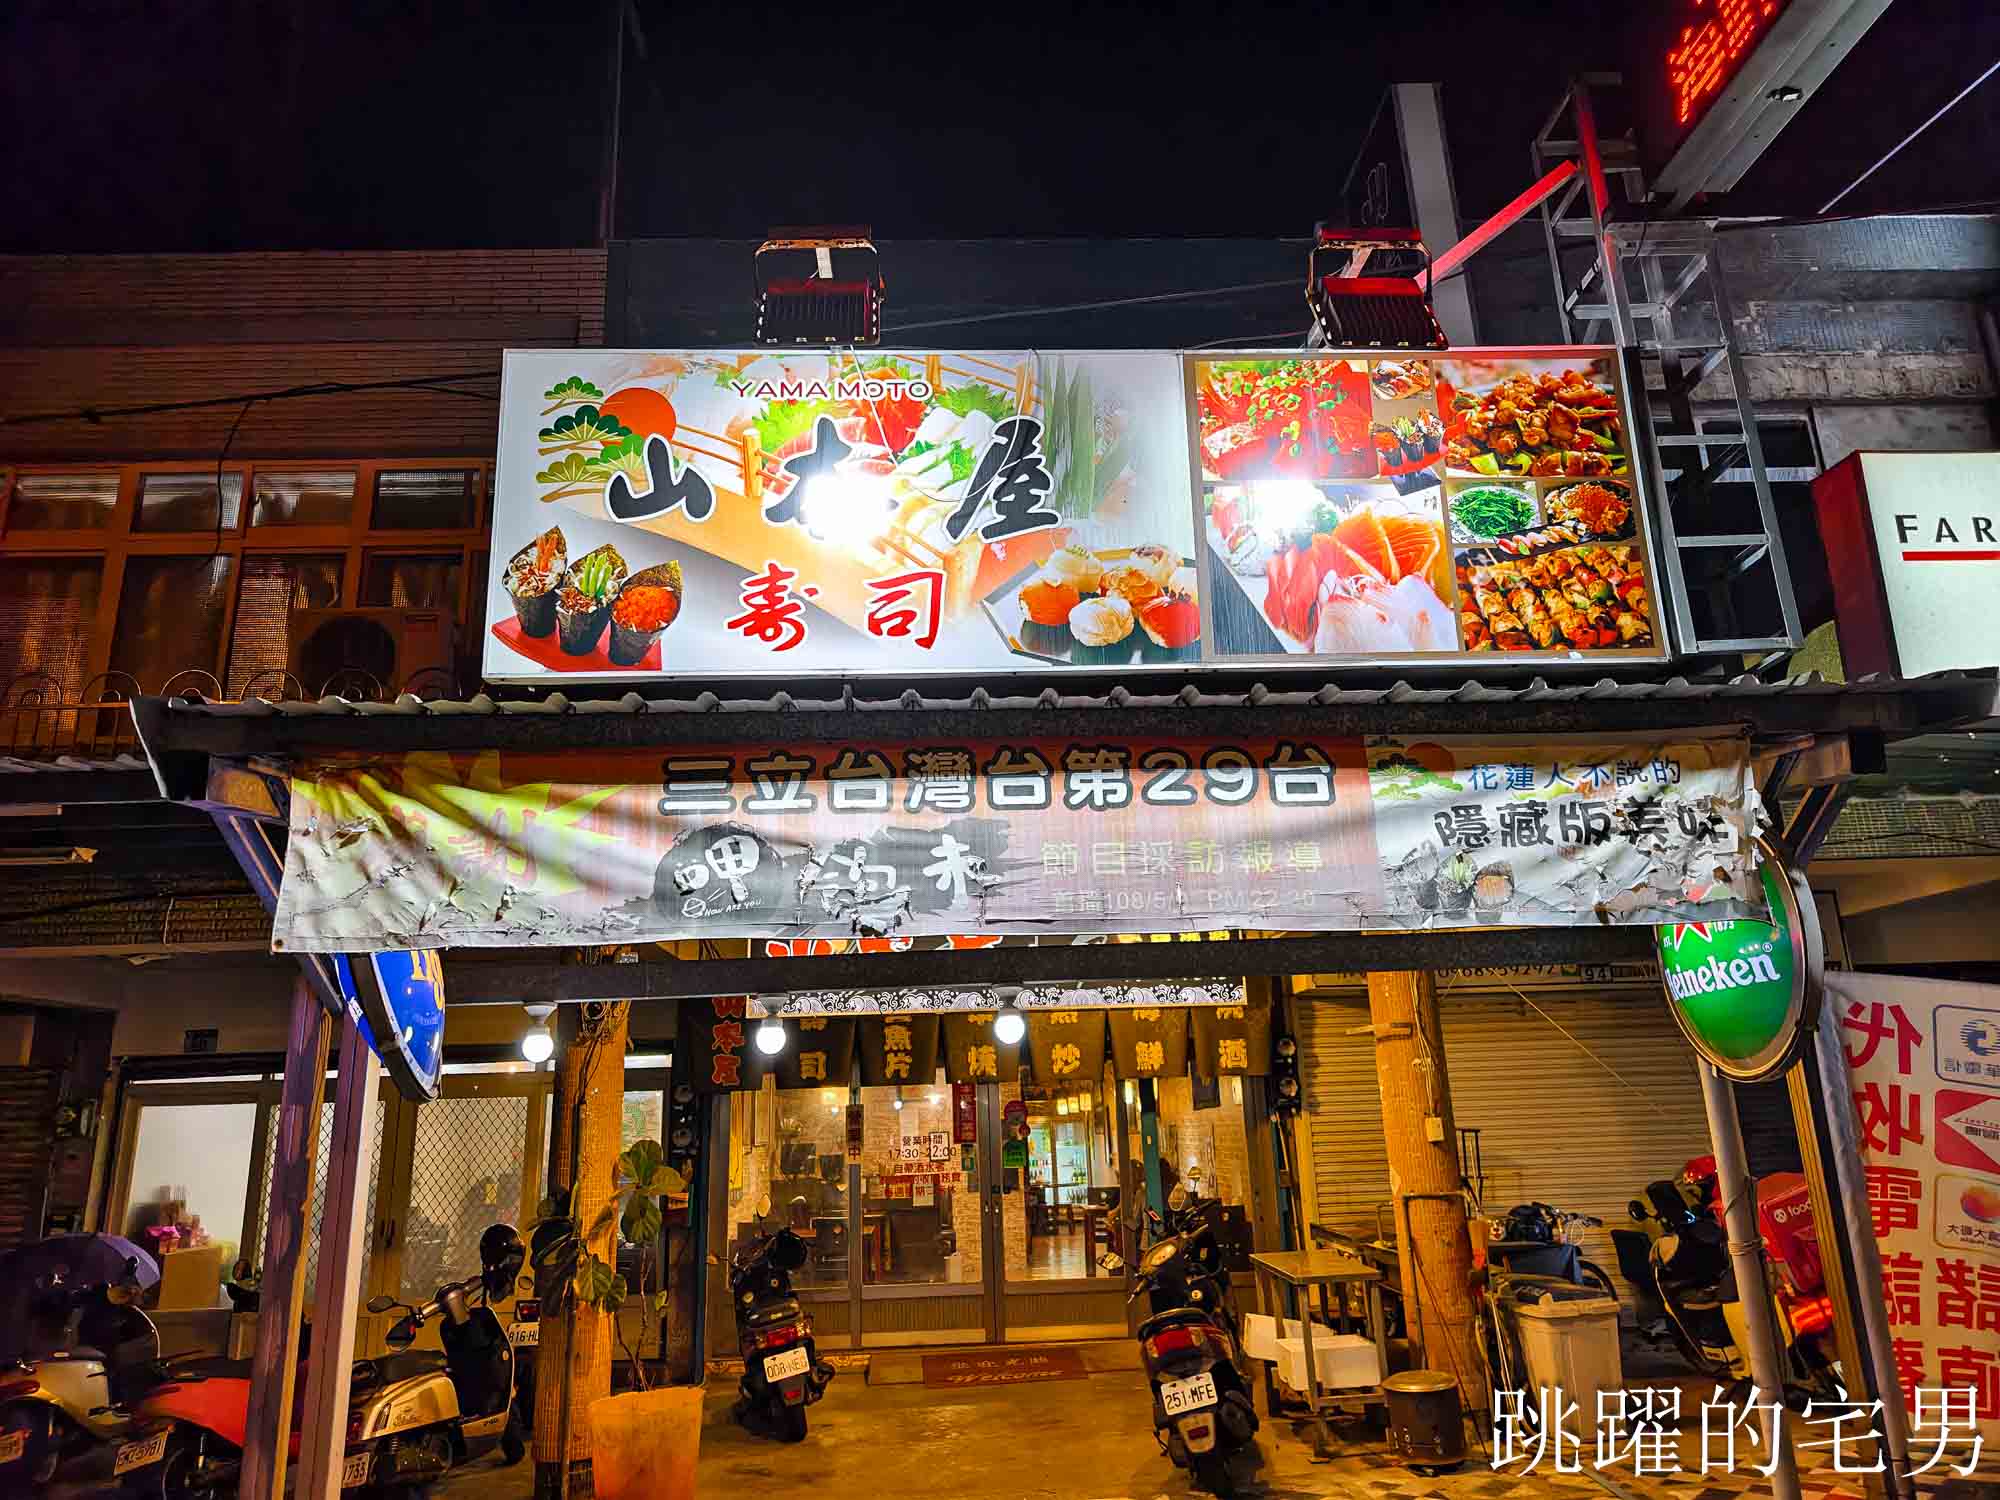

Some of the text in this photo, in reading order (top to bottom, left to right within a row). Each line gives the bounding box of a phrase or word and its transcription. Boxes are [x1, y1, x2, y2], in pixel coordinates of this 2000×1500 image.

[732, 379, 931, 399] YAMA MOTO
[1894, 514, 1998, 544] FAR
[660, 742, 1336, 815] 三立台灣台第29台
[726, 903, 742, 912] ARE
[743, 898, 762, 909] YOU
[1164, 1383, 1215, 1411] 251-MFE
